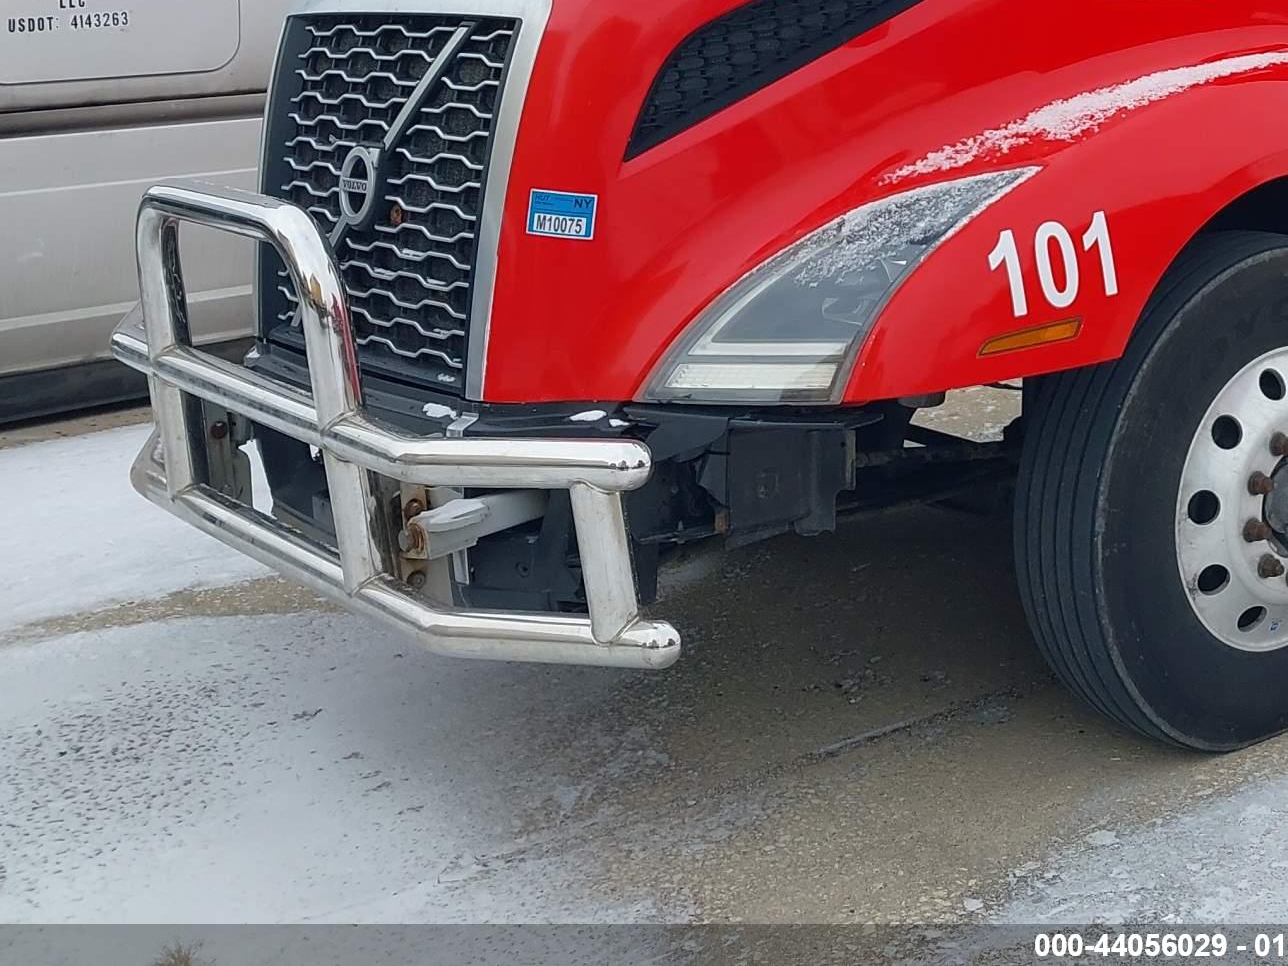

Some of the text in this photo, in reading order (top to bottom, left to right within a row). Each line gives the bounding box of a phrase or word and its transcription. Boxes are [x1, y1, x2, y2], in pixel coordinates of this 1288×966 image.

[8, 11, 129, 33] USDOT: 4143263
[343, 179, 367, 191] VOLVO
[574, 199, 592, 208] NY
[536, 214, 582, 234] M10075
[987, 210, 1119, 318] 101
